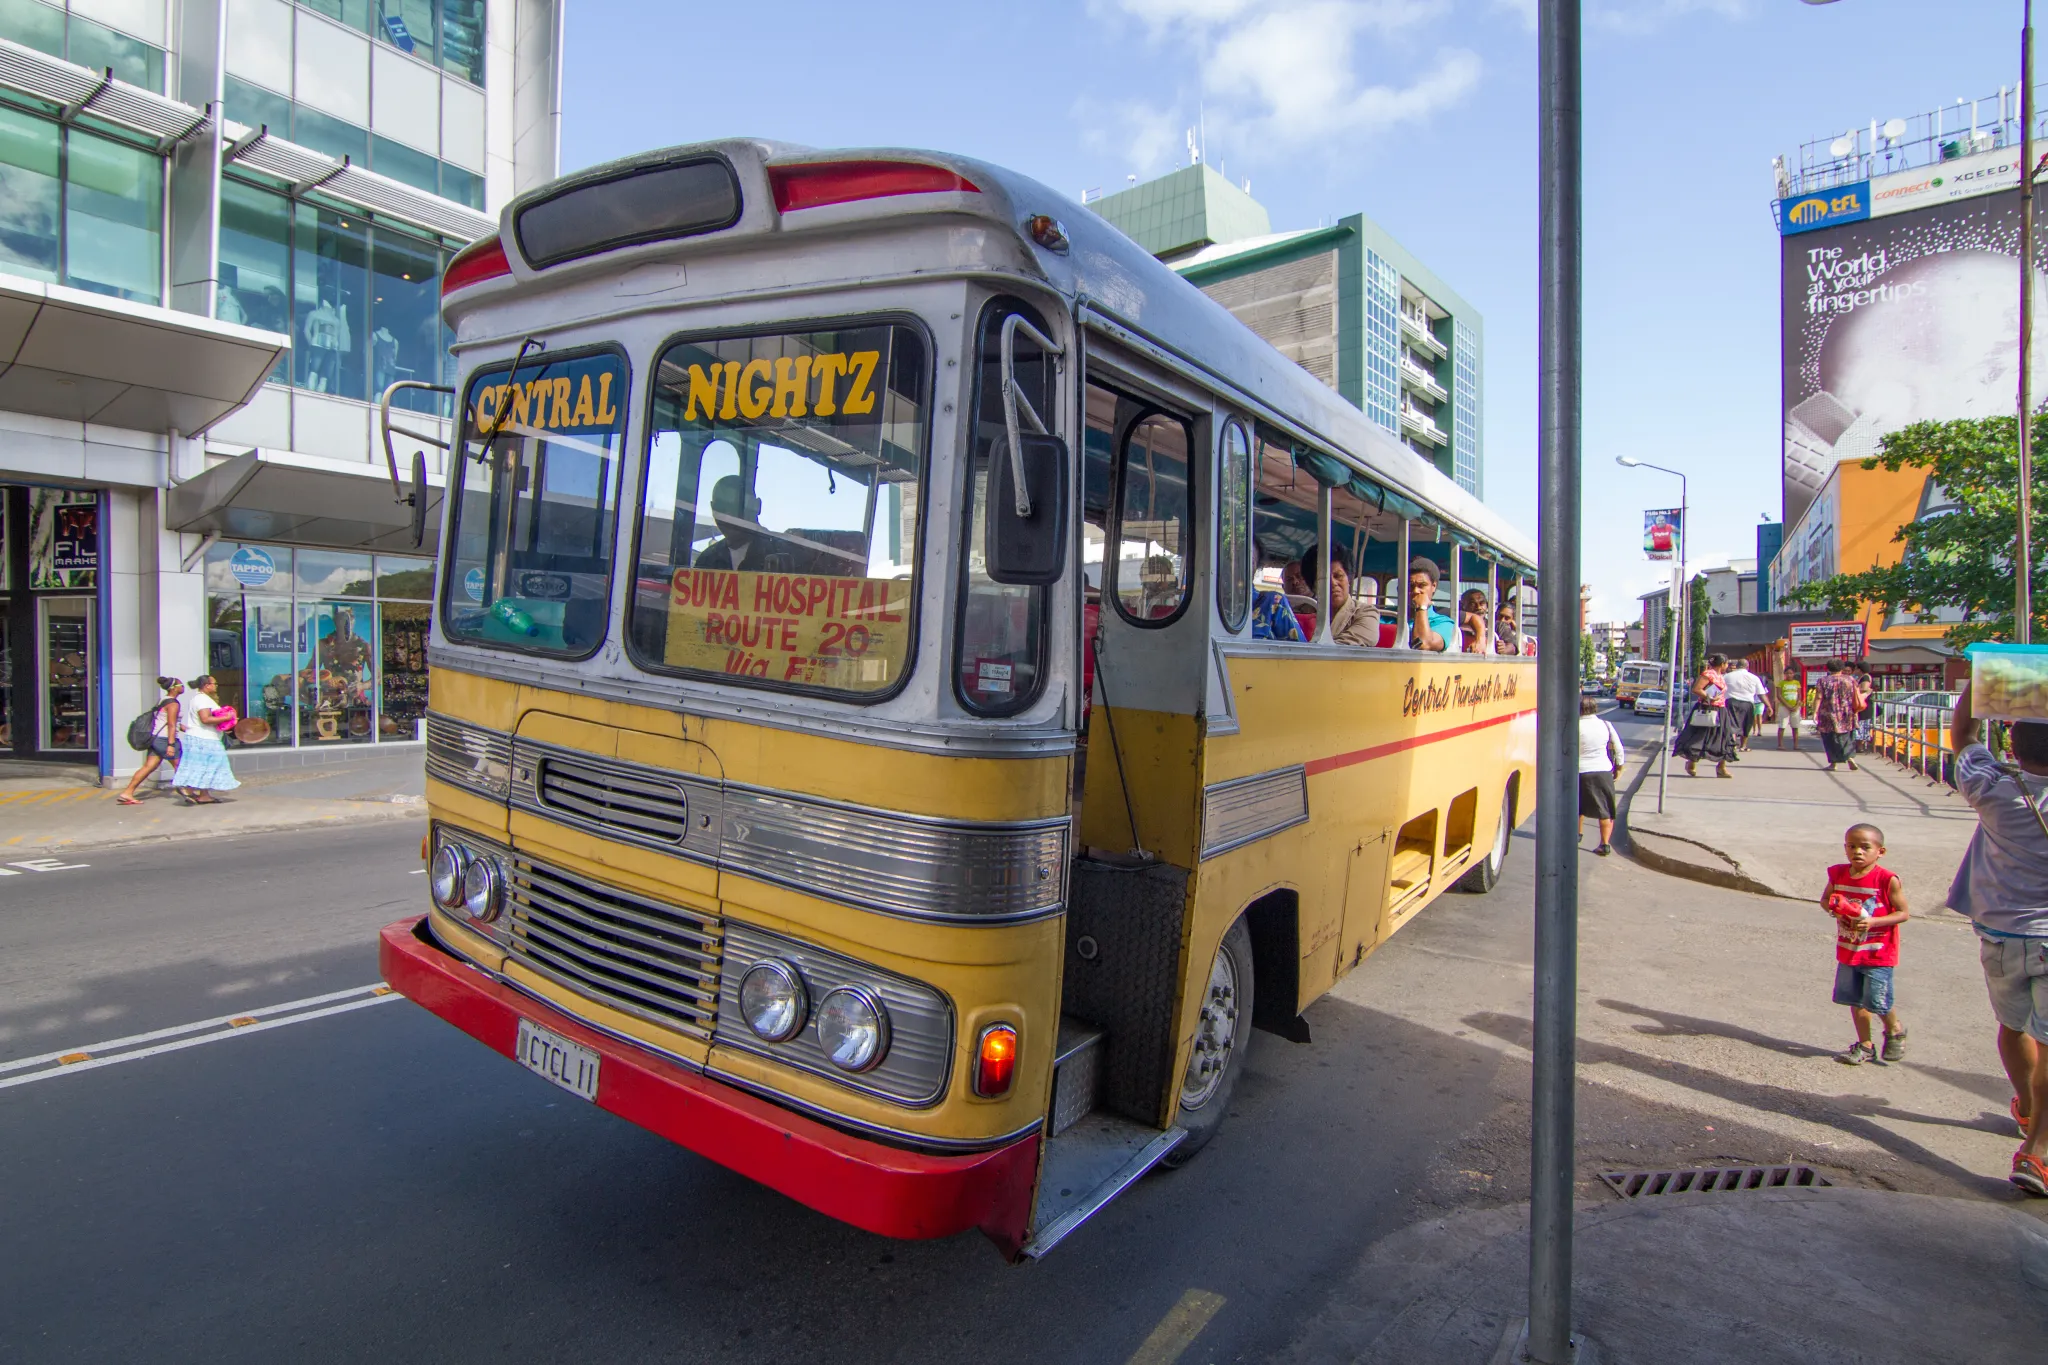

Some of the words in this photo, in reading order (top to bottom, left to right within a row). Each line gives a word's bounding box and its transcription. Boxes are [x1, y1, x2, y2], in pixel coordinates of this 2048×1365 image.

[1874, 180, 1931, 200] connect
[1807, 247, 1842, 263] The
[1807, 250, 1886, 282] World
[1807, 279, 1825, 294] at
[1833, 270, 1875, 293] your
[1808, 280, 1928, 314] fingertips
[684, 350, 880, 421] NIGHTZ
[476, 372, 617, 433] CENTRAL
[55, 557, 97, 566] MARKE
[231, 563, 273, 574] TAPPOO
[673, 570, 740, 611] SUVA
[754, 576, 902, 623] HOSPITAL
[705, 612, 799, 651] ROUTE
[818, 622, 870, 657] 20
[725, 650, 770, 678] Via
[1402, 676, 1451, 718] Central
[1451, 674, 1493, 721] Transport
[530, 1035, 571, 1085] CTCL
